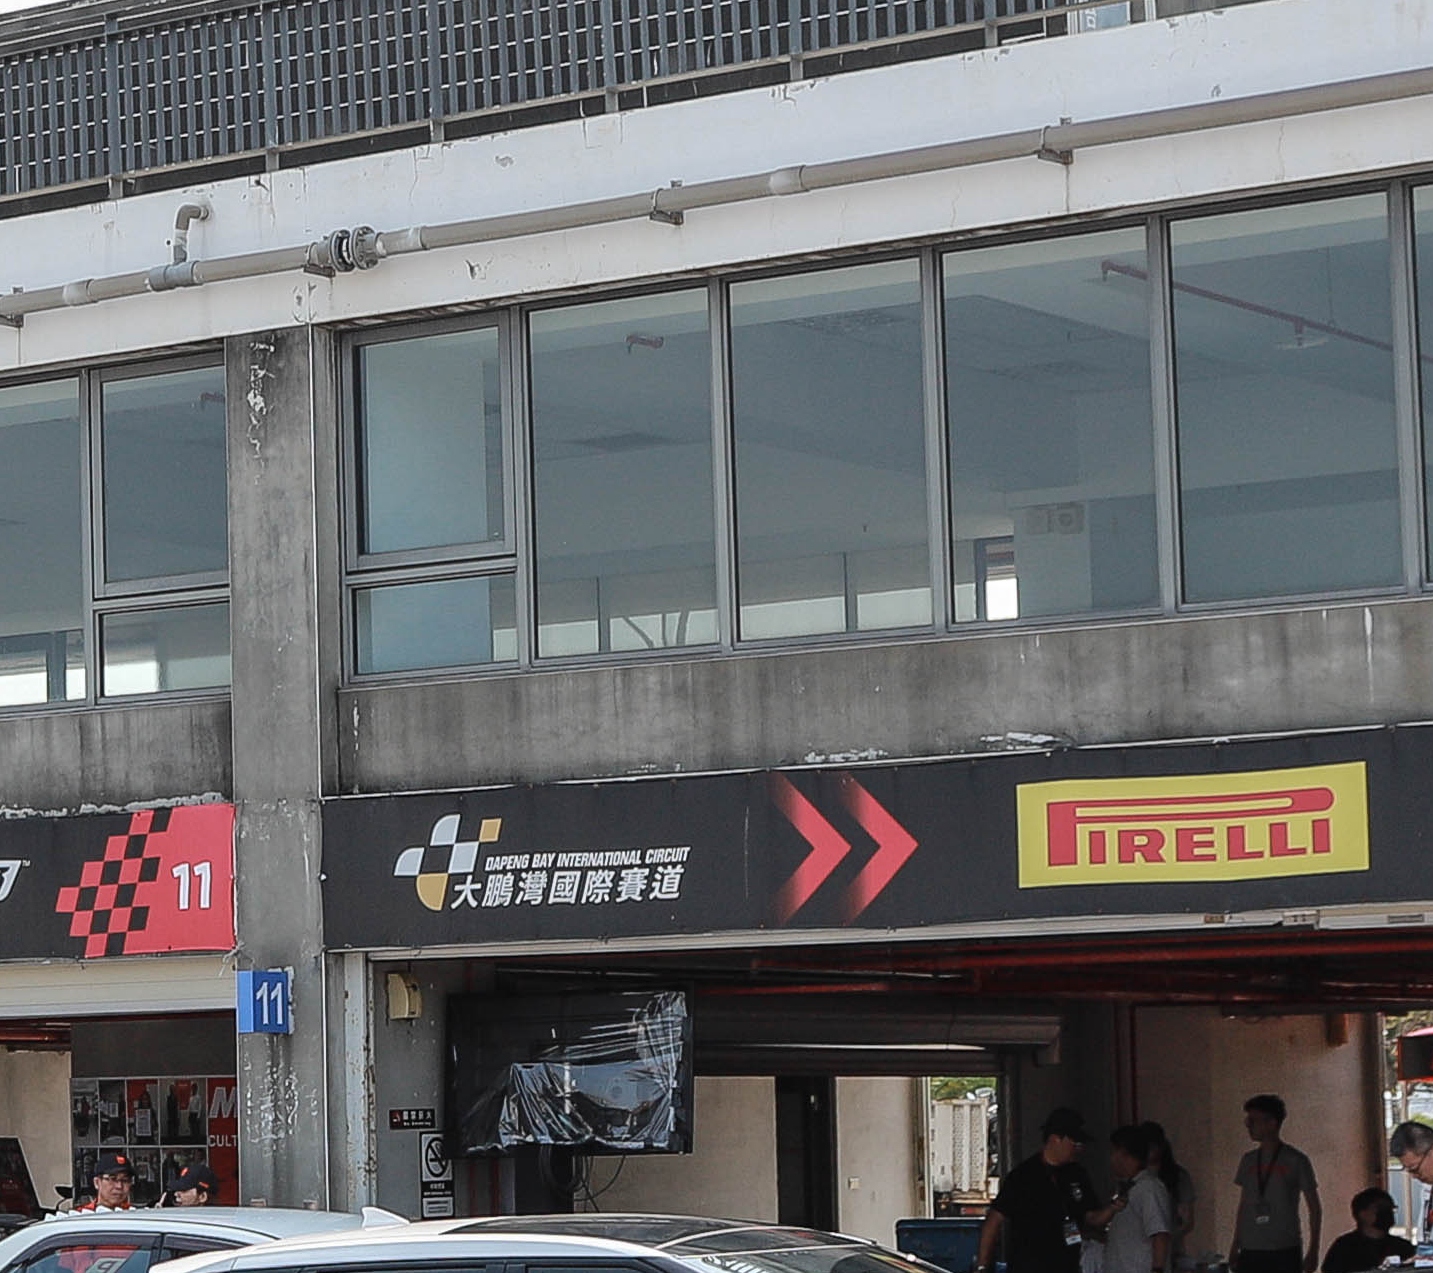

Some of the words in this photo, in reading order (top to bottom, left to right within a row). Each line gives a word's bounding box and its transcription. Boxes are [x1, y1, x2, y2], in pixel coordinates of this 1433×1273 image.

[1047, 787, 1334, 867] PIRELLI
[485, 854, 529, 871] DAPENG
[531, 853, 556, 869] BAY
[556, 849, 642, 868] INTERNATIONAL
[645, 846, 691, 864] CIRCUIT
[172, 861, 212, 911] 11
[451, 865, 684, 910] 大鵬灣國際賽道
[256, 980, 286, 1027] 11
